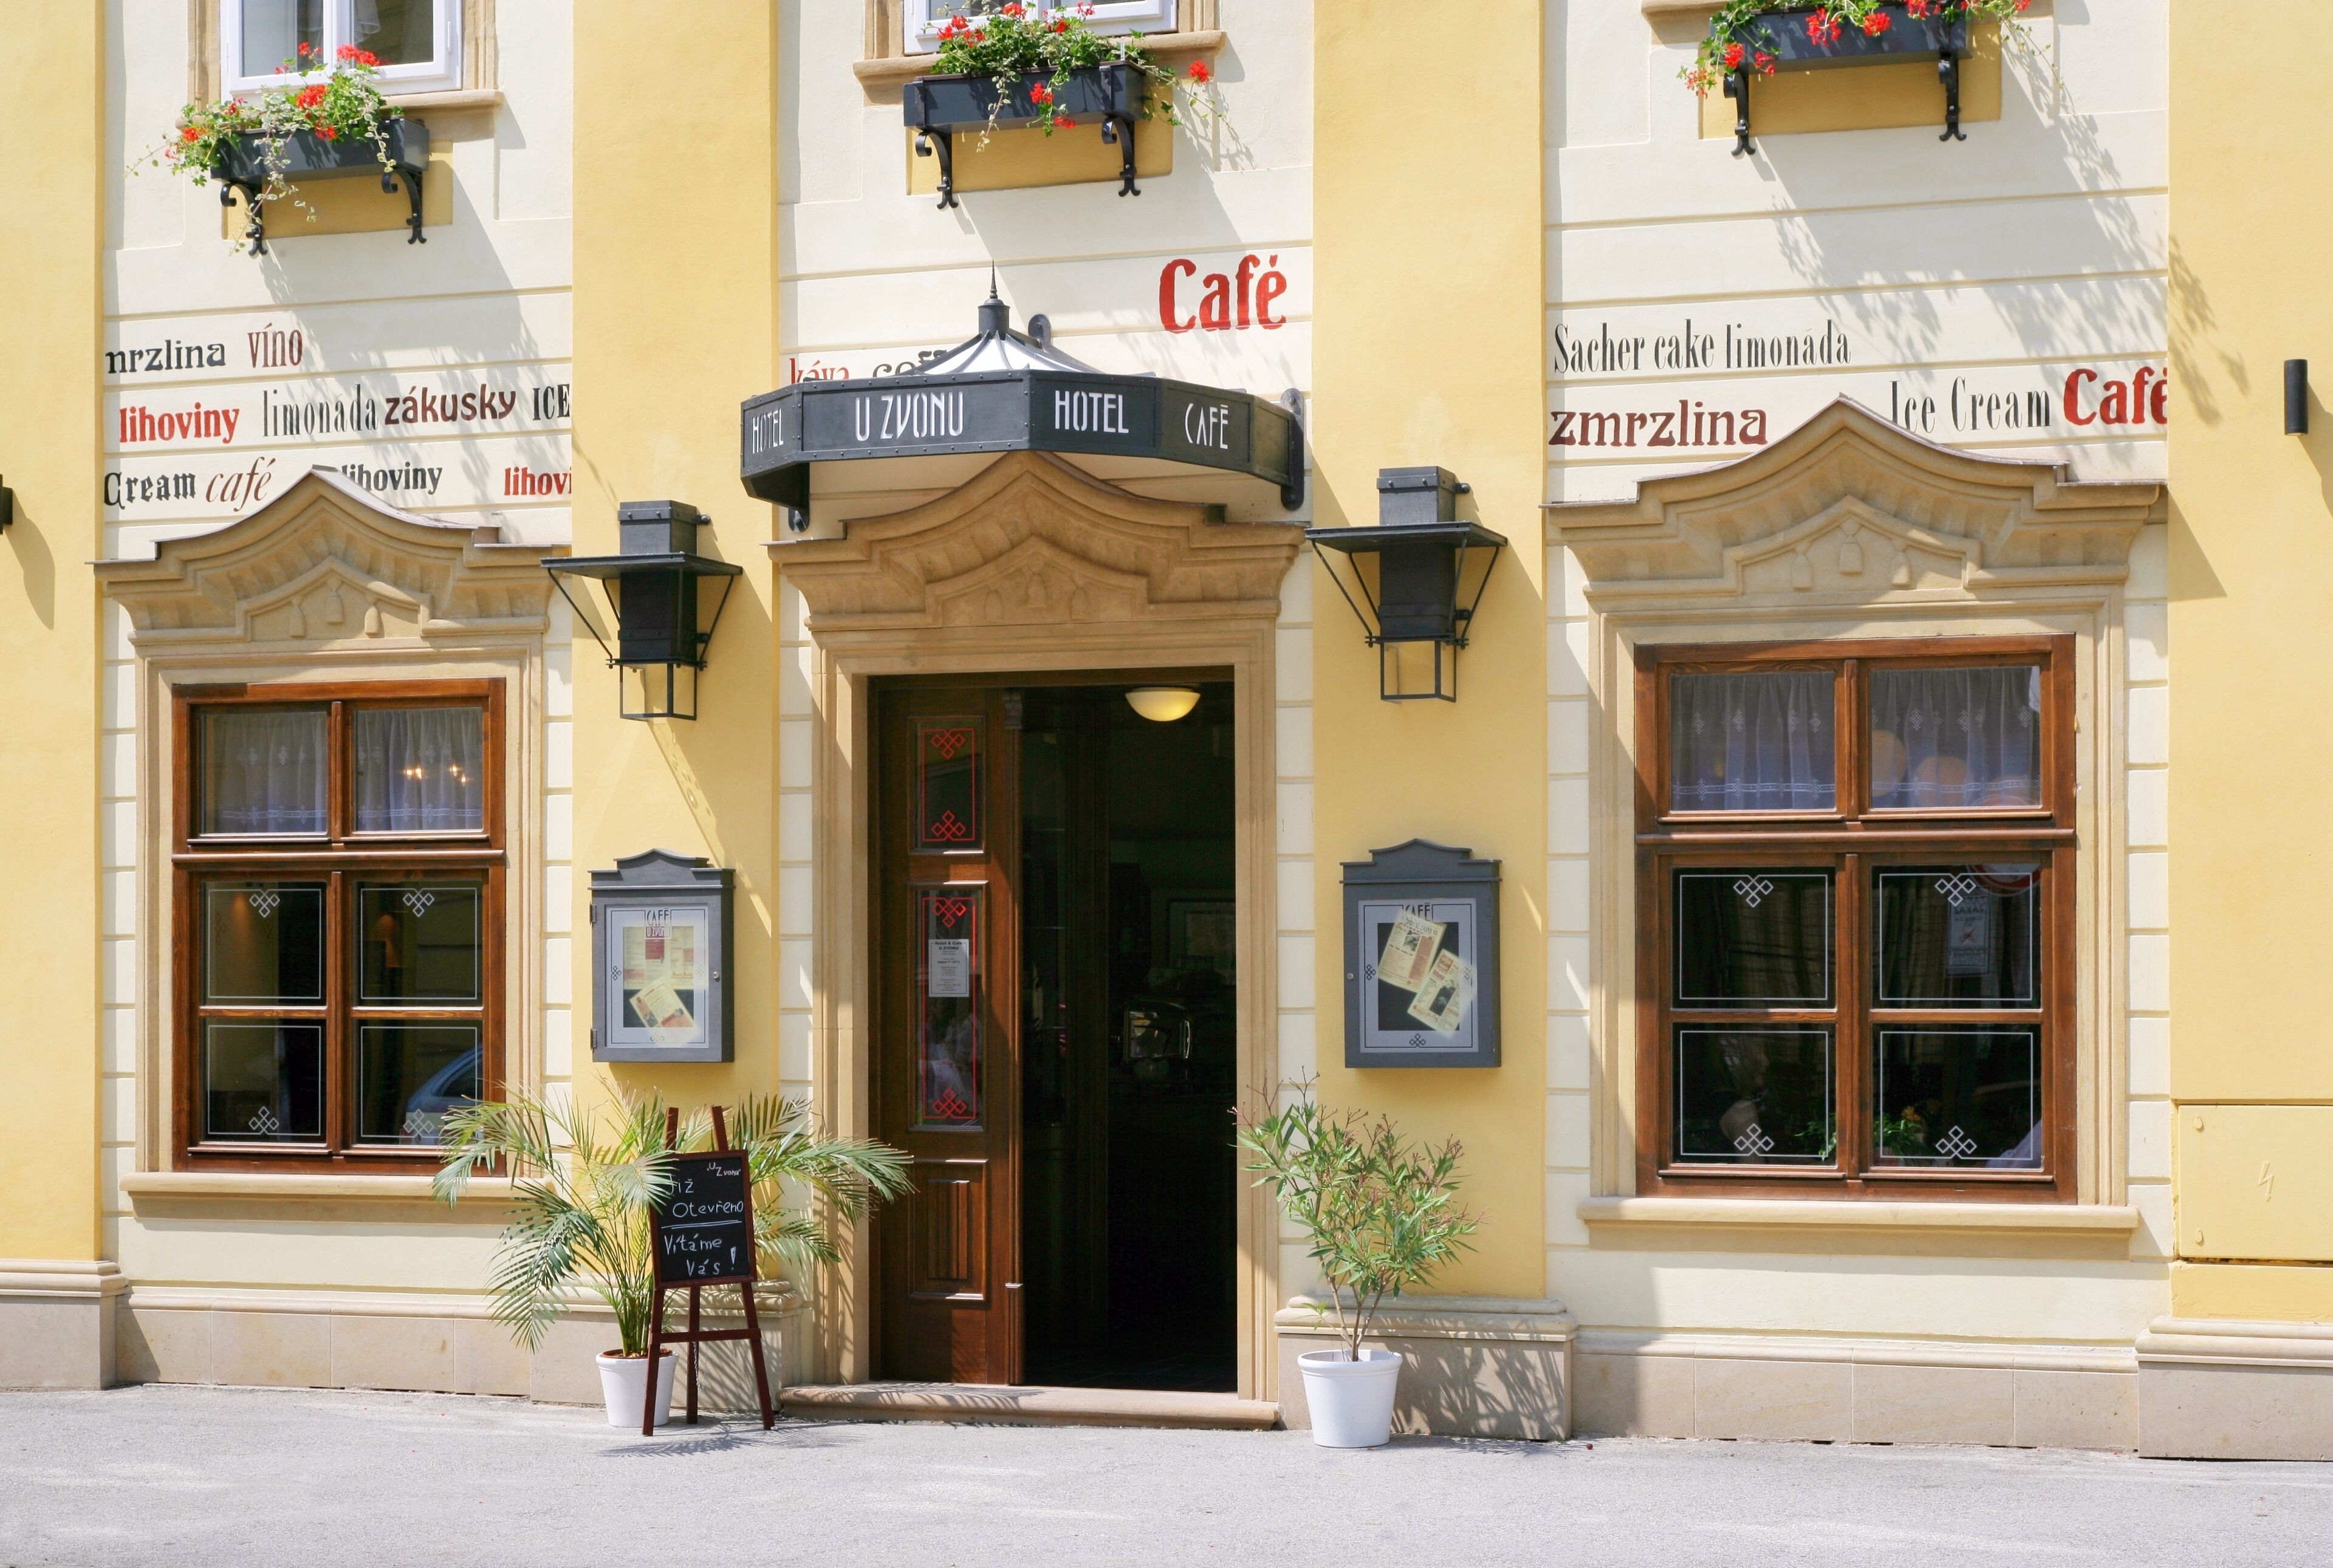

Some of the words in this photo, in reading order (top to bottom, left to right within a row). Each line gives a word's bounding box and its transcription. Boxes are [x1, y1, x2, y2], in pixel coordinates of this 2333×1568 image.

[1159, 255, 1287, 334] Café
[247, 322, 303, 368] víno
[1554, 323, 1645, 374] Sacher
[1654, 319, 1715, 369] cake
[1725, 319, 1851, 369] limonáda
[119, 402, 240, 444] lihoviny
[262, 384, 379, 437] limonáda
[384, 384, 516, 425] zákusky
[532, 383, 570, 421] ICE
[855, 395, 870, 442] U
[880, 391, 963, 439] ZVONU
[1055, 390, 1129, 434] HOTEL
[1548, 399, 1769, 447] zmrzlina
[1889, 380, 1936, 434] Ice
[1951, 376, 2052, 433] Cream
[752, 408, 784, 454] HOTEL
[103, 471, 196, 510] Cream
[205, 456, 276, 512] café
[646, 926, 651, 937] U
[673, 1200, 744, 1218] Otevřeno
[664, 1233, 722, 1255] Vítáme
[687, 1258, 721, 1276] Vás
